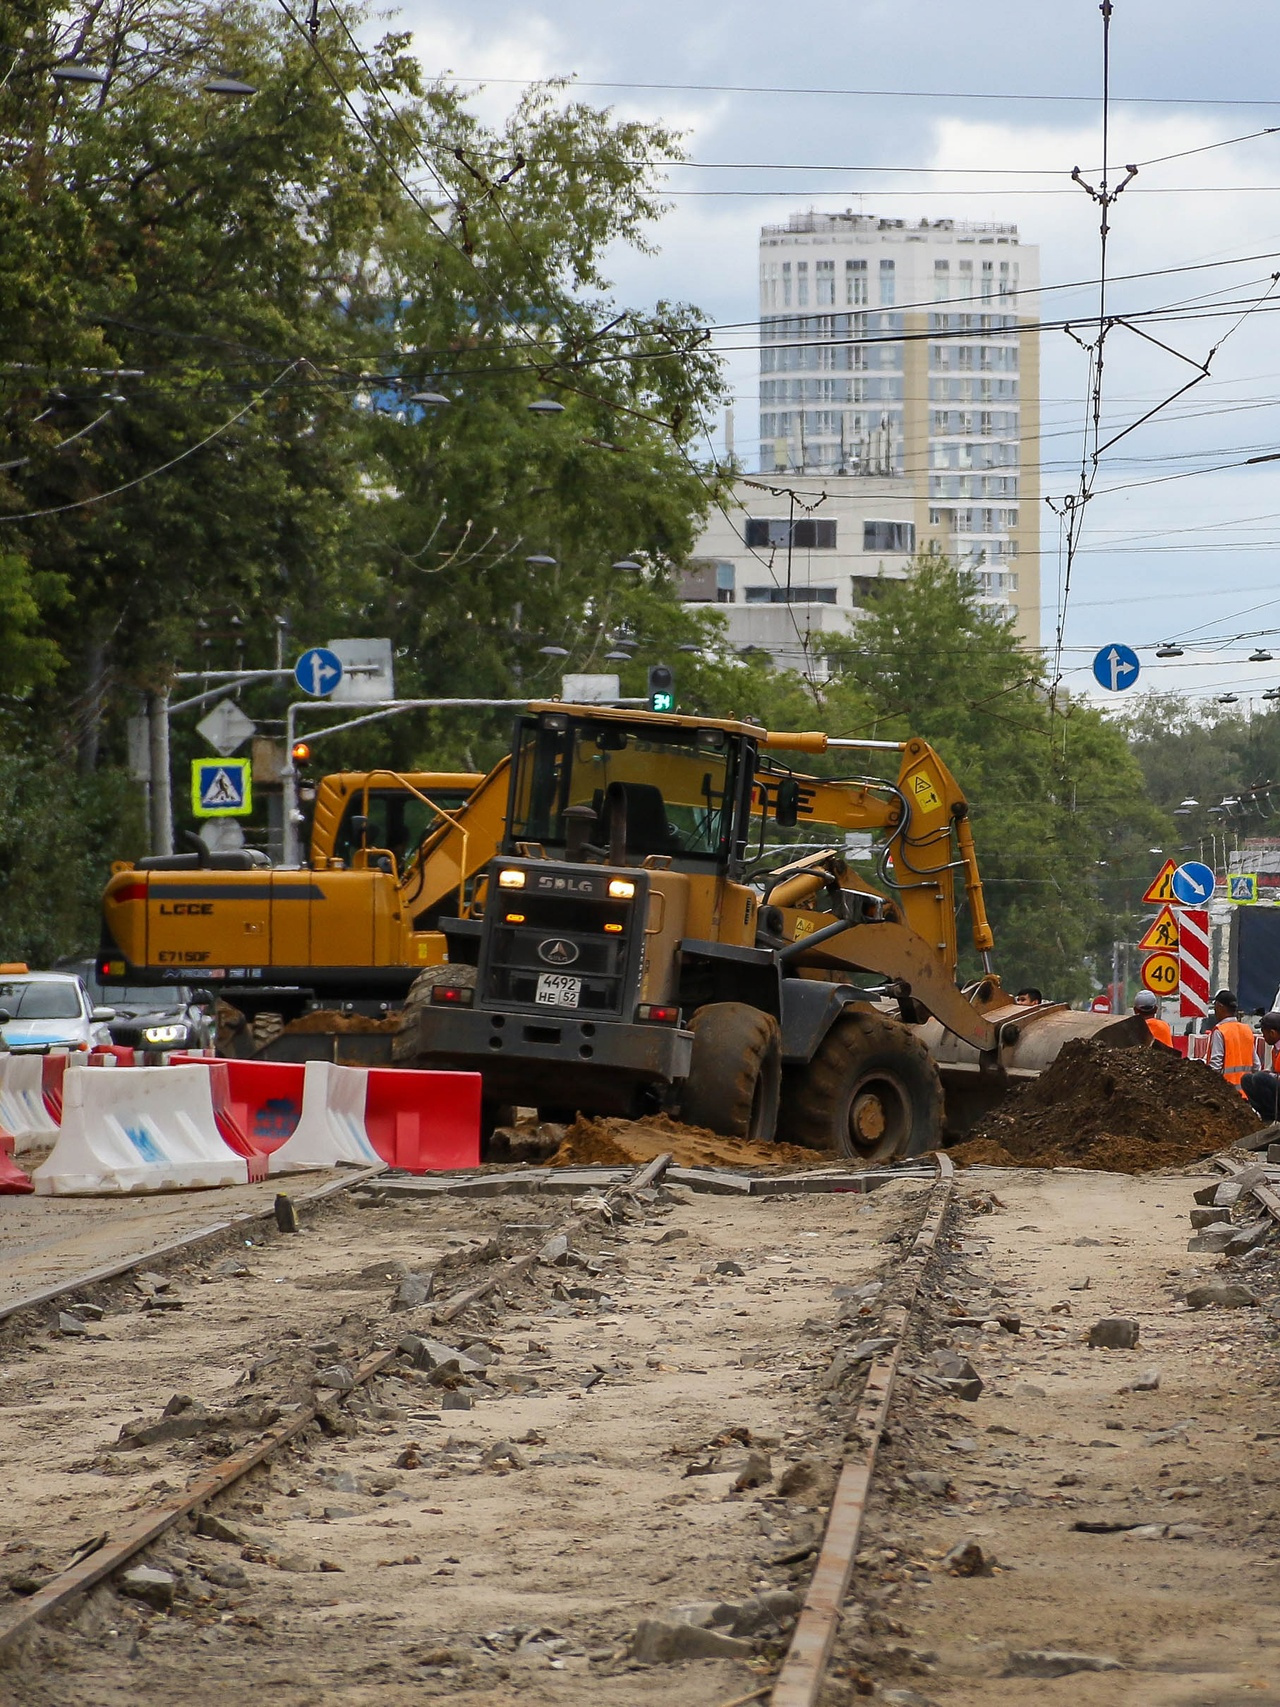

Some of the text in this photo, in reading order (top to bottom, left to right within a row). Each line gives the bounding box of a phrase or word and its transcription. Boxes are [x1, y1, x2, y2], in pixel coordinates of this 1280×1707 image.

[654, 694, 670, 710] 34
[1151, 965, 1176, 983] 40
[543, 974, 576, 991] 4492
[563, 992, 576, 1003] 52
